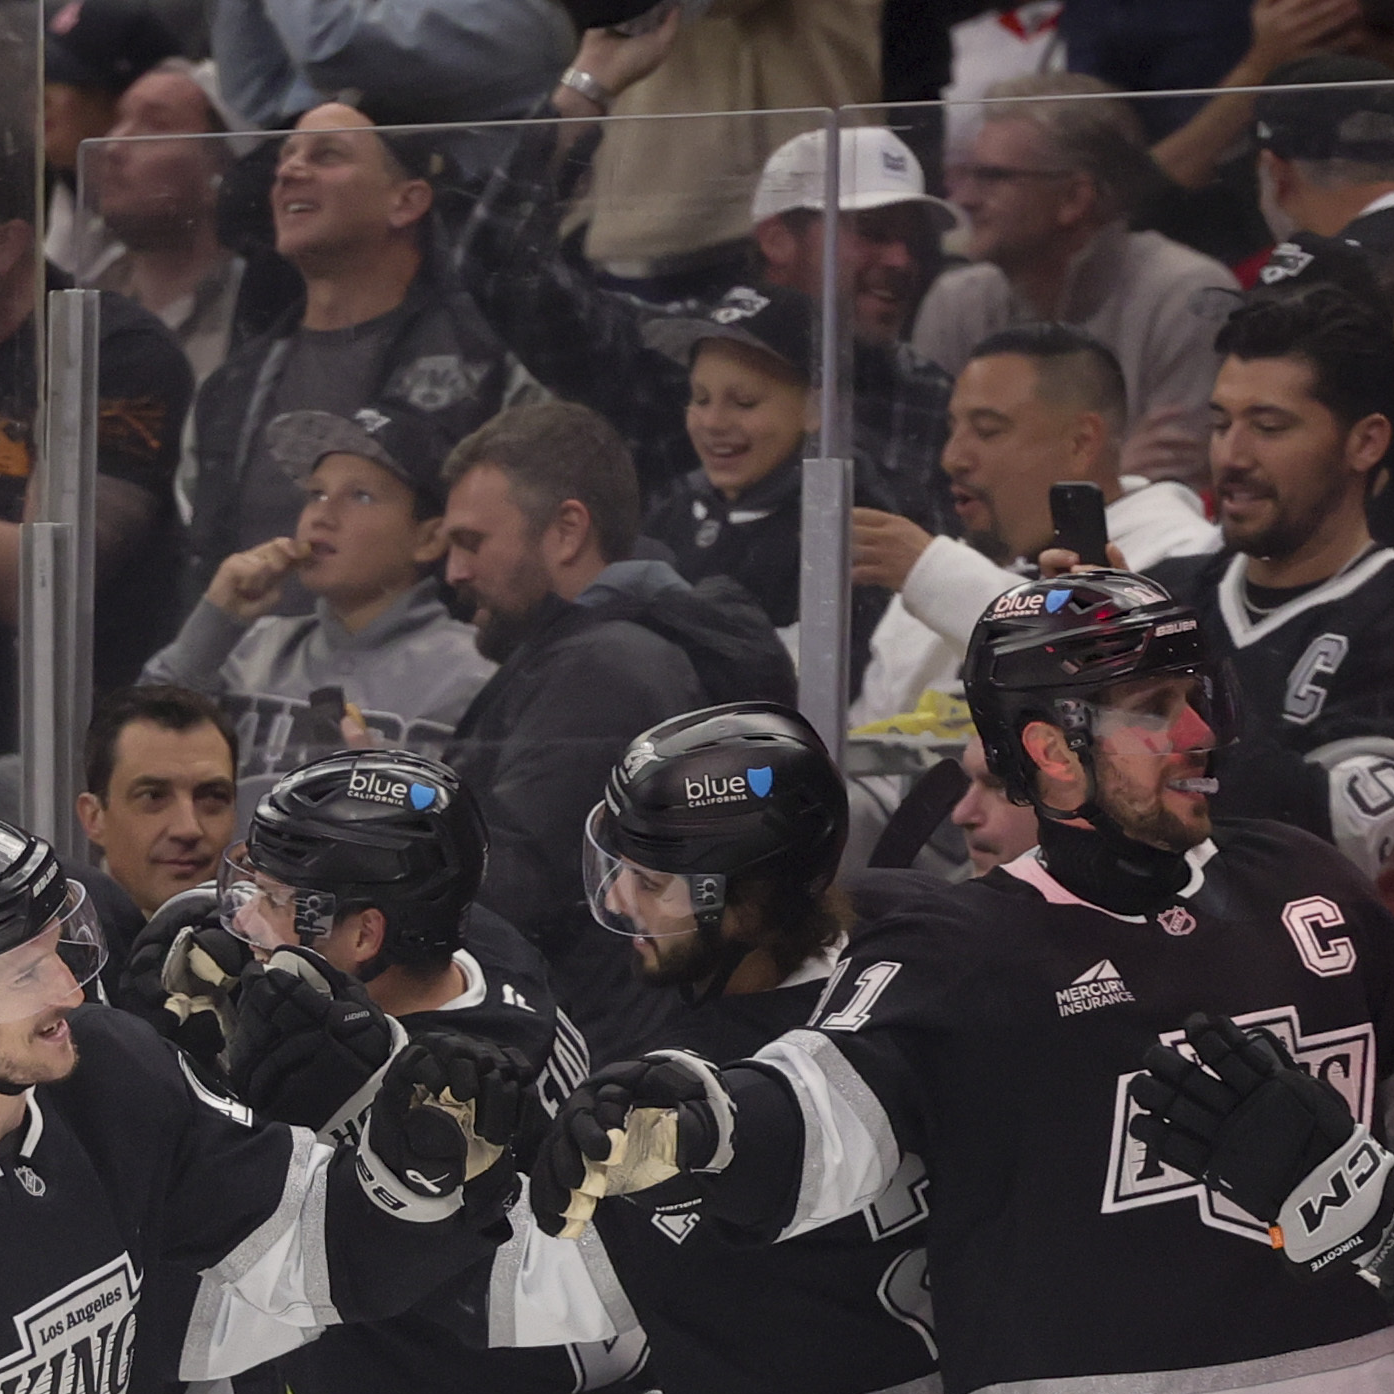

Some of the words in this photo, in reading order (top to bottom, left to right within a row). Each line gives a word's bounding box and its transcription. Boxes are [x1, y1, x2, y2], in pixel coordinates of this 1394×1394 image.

[994, 594, 1044, 613] blue
[347, 790, 404, 806] CALIFORNIA
[349, 770, 408, 799] blue
[684, 774, 746, 800] blue
[688, 793, 748, 808] CALIFORNIA
[1281, 895, 1357, 978] C
[1056, 979, 1126, 1005] MERCURY
[1058, 990, 1136, 1018] INSURANCE
[1296, 1139, 1387, 1238] CM
[1310, 1235, 1364, 1272] TURCOTTE
[38, 1317, 65, 1347] Los
[66, 1285, 123, 1329] Angeles
